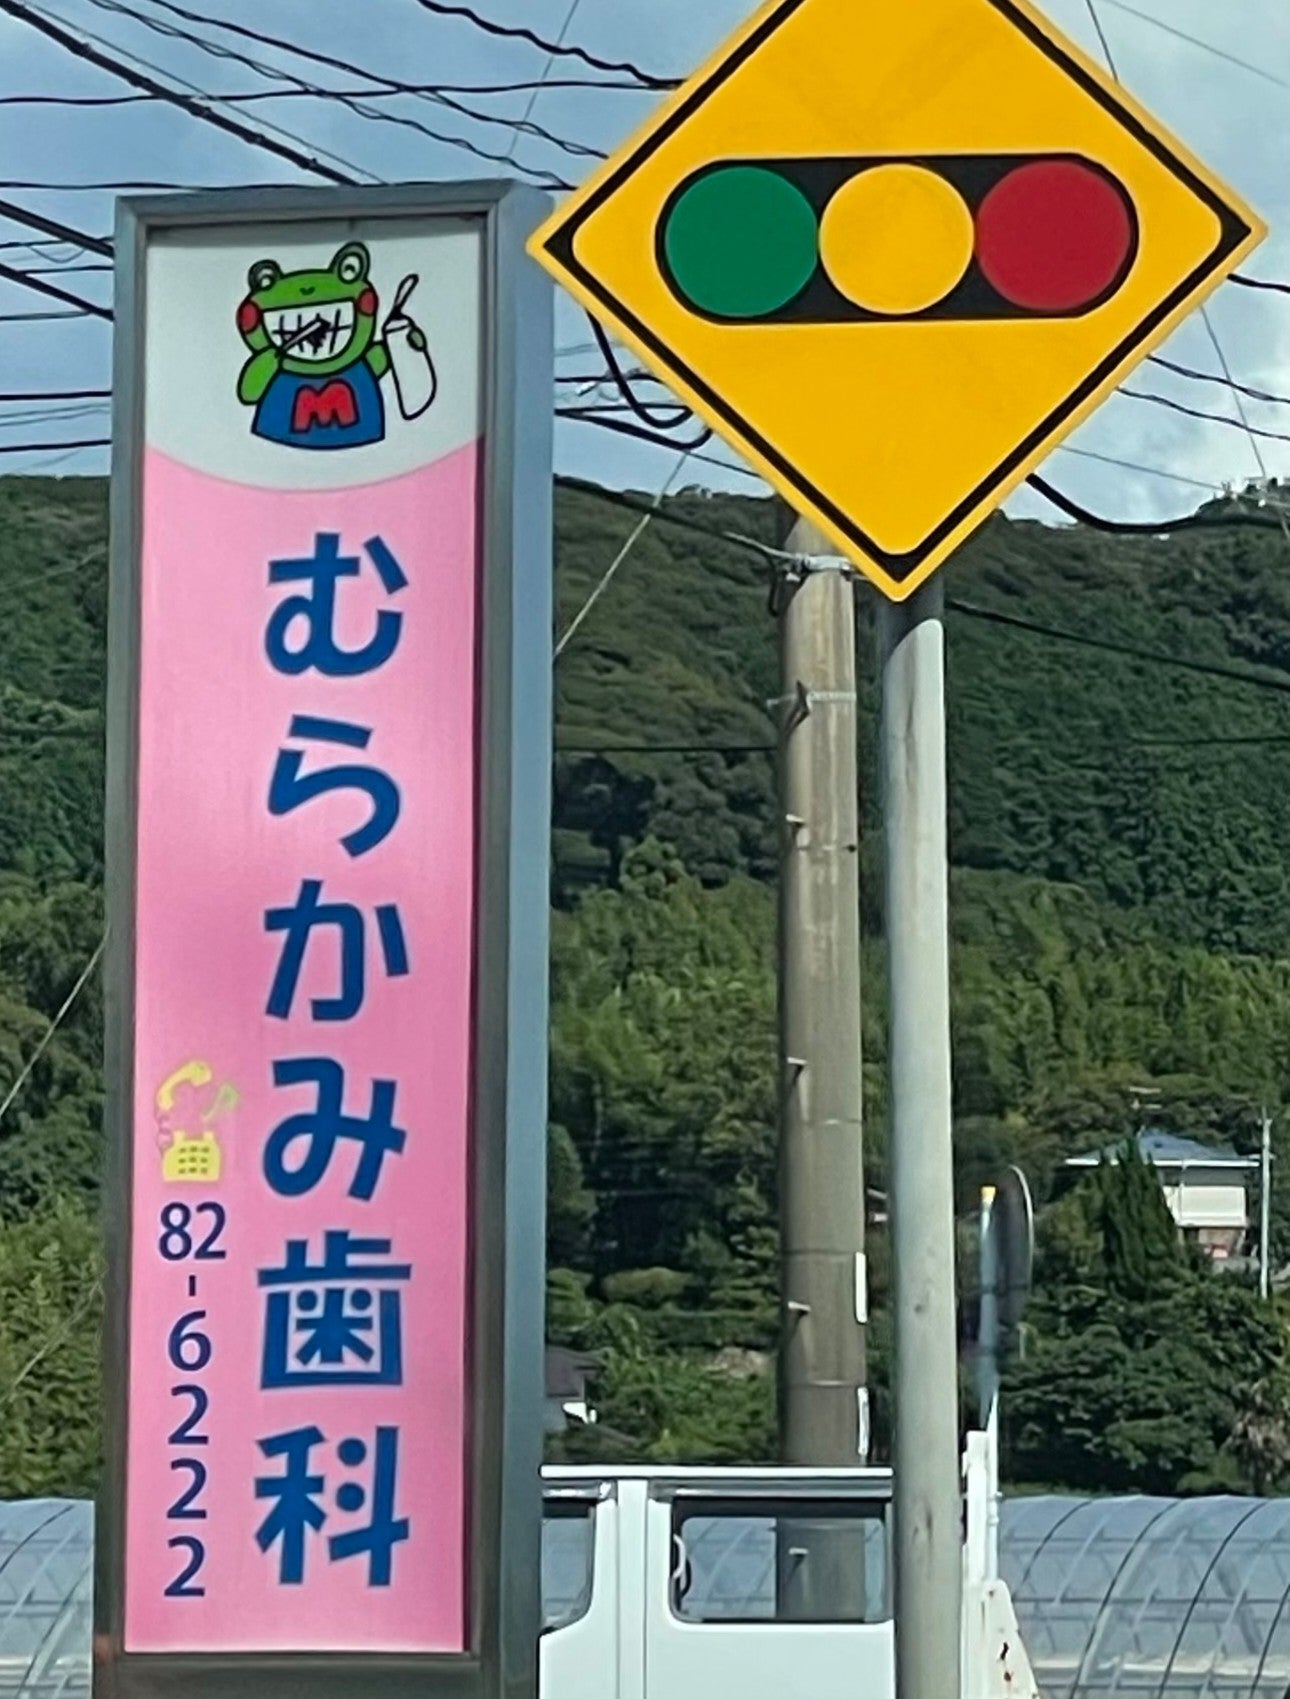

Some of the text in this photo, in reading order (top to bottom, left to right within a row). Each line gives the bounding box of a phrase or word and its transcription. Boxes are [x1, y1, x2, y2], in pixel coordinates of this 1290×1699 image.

[290, 378, 359, 433] M
[254, 532, 412, 1588] むらかみ歯科
[158, 1201, 227, 1598] 82-6222
